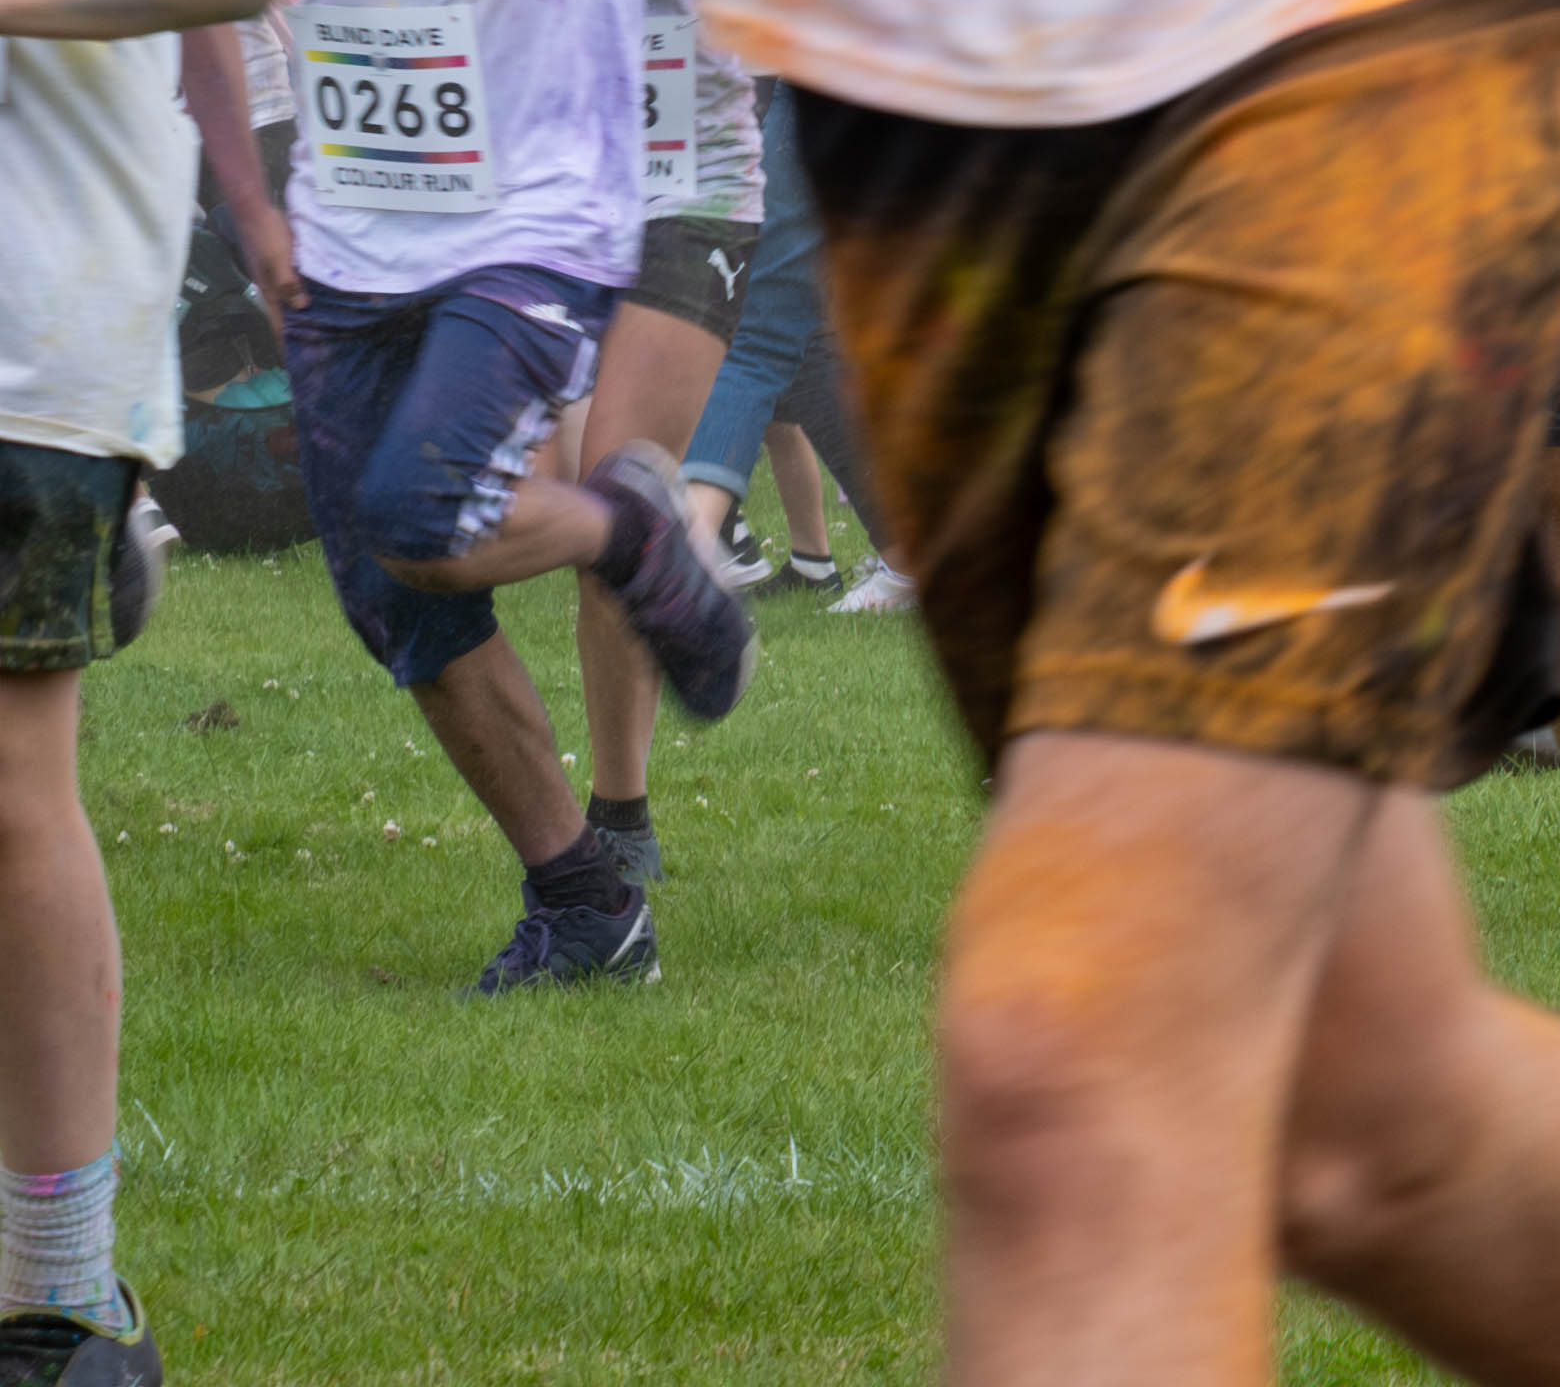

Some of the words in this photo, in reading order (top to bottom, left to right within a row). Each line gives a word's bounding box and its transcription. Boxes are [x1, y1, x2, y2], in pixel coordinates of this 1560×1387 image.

[315, 22, 376, 45] BLIND
[379, 27, 445, 47] DAVE
[317, 75, 472, 138] 0268
[333, 166, 417, 190] COLOUR
[422, 174, 473, 193] RUN
